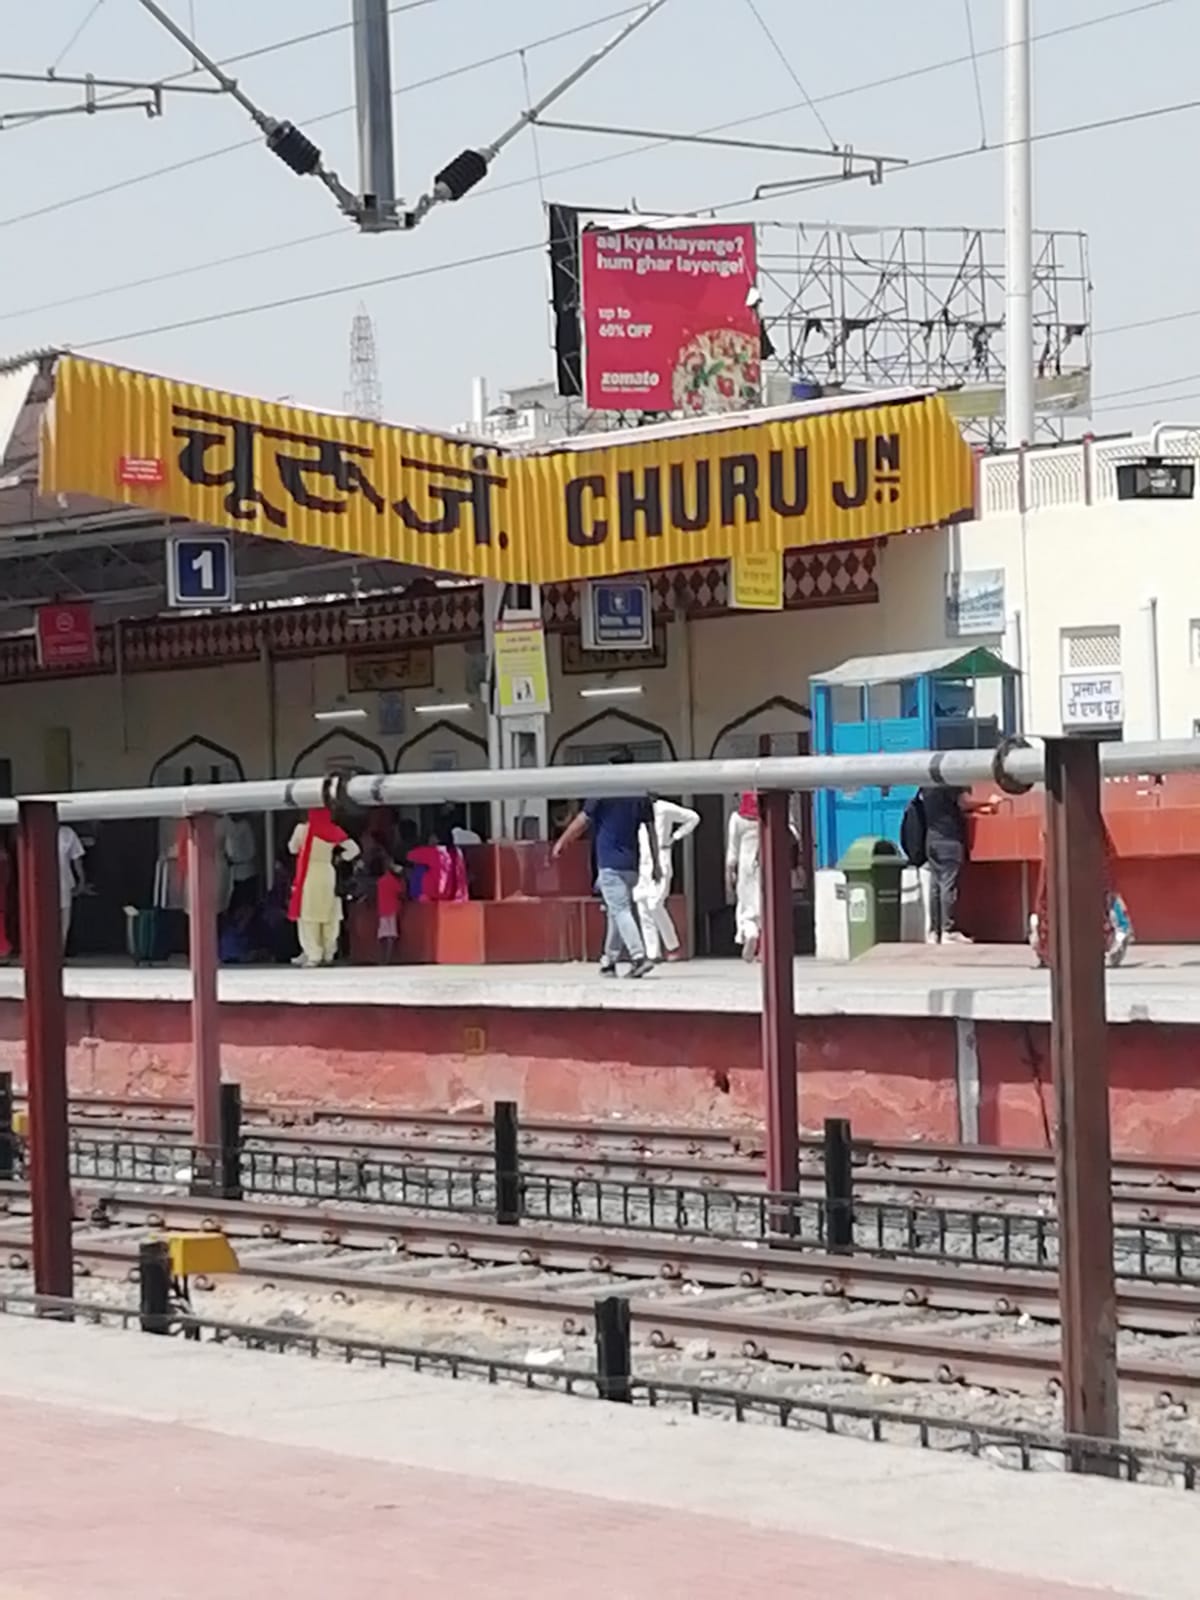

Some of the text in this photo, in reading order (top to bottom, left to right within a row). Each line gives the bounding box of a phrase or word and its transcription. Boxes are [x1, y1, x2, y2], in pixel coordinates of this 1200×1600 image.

[596, 233, 744, 256] aaj kya khayenge?
[596, 252, 634, 269] hum
[635, 254, 674, 275] ghar
[602, 370, 660, 386] zomato
[564, 446, 809, 547] CHURU
[192, 550, 213, 590] 1
